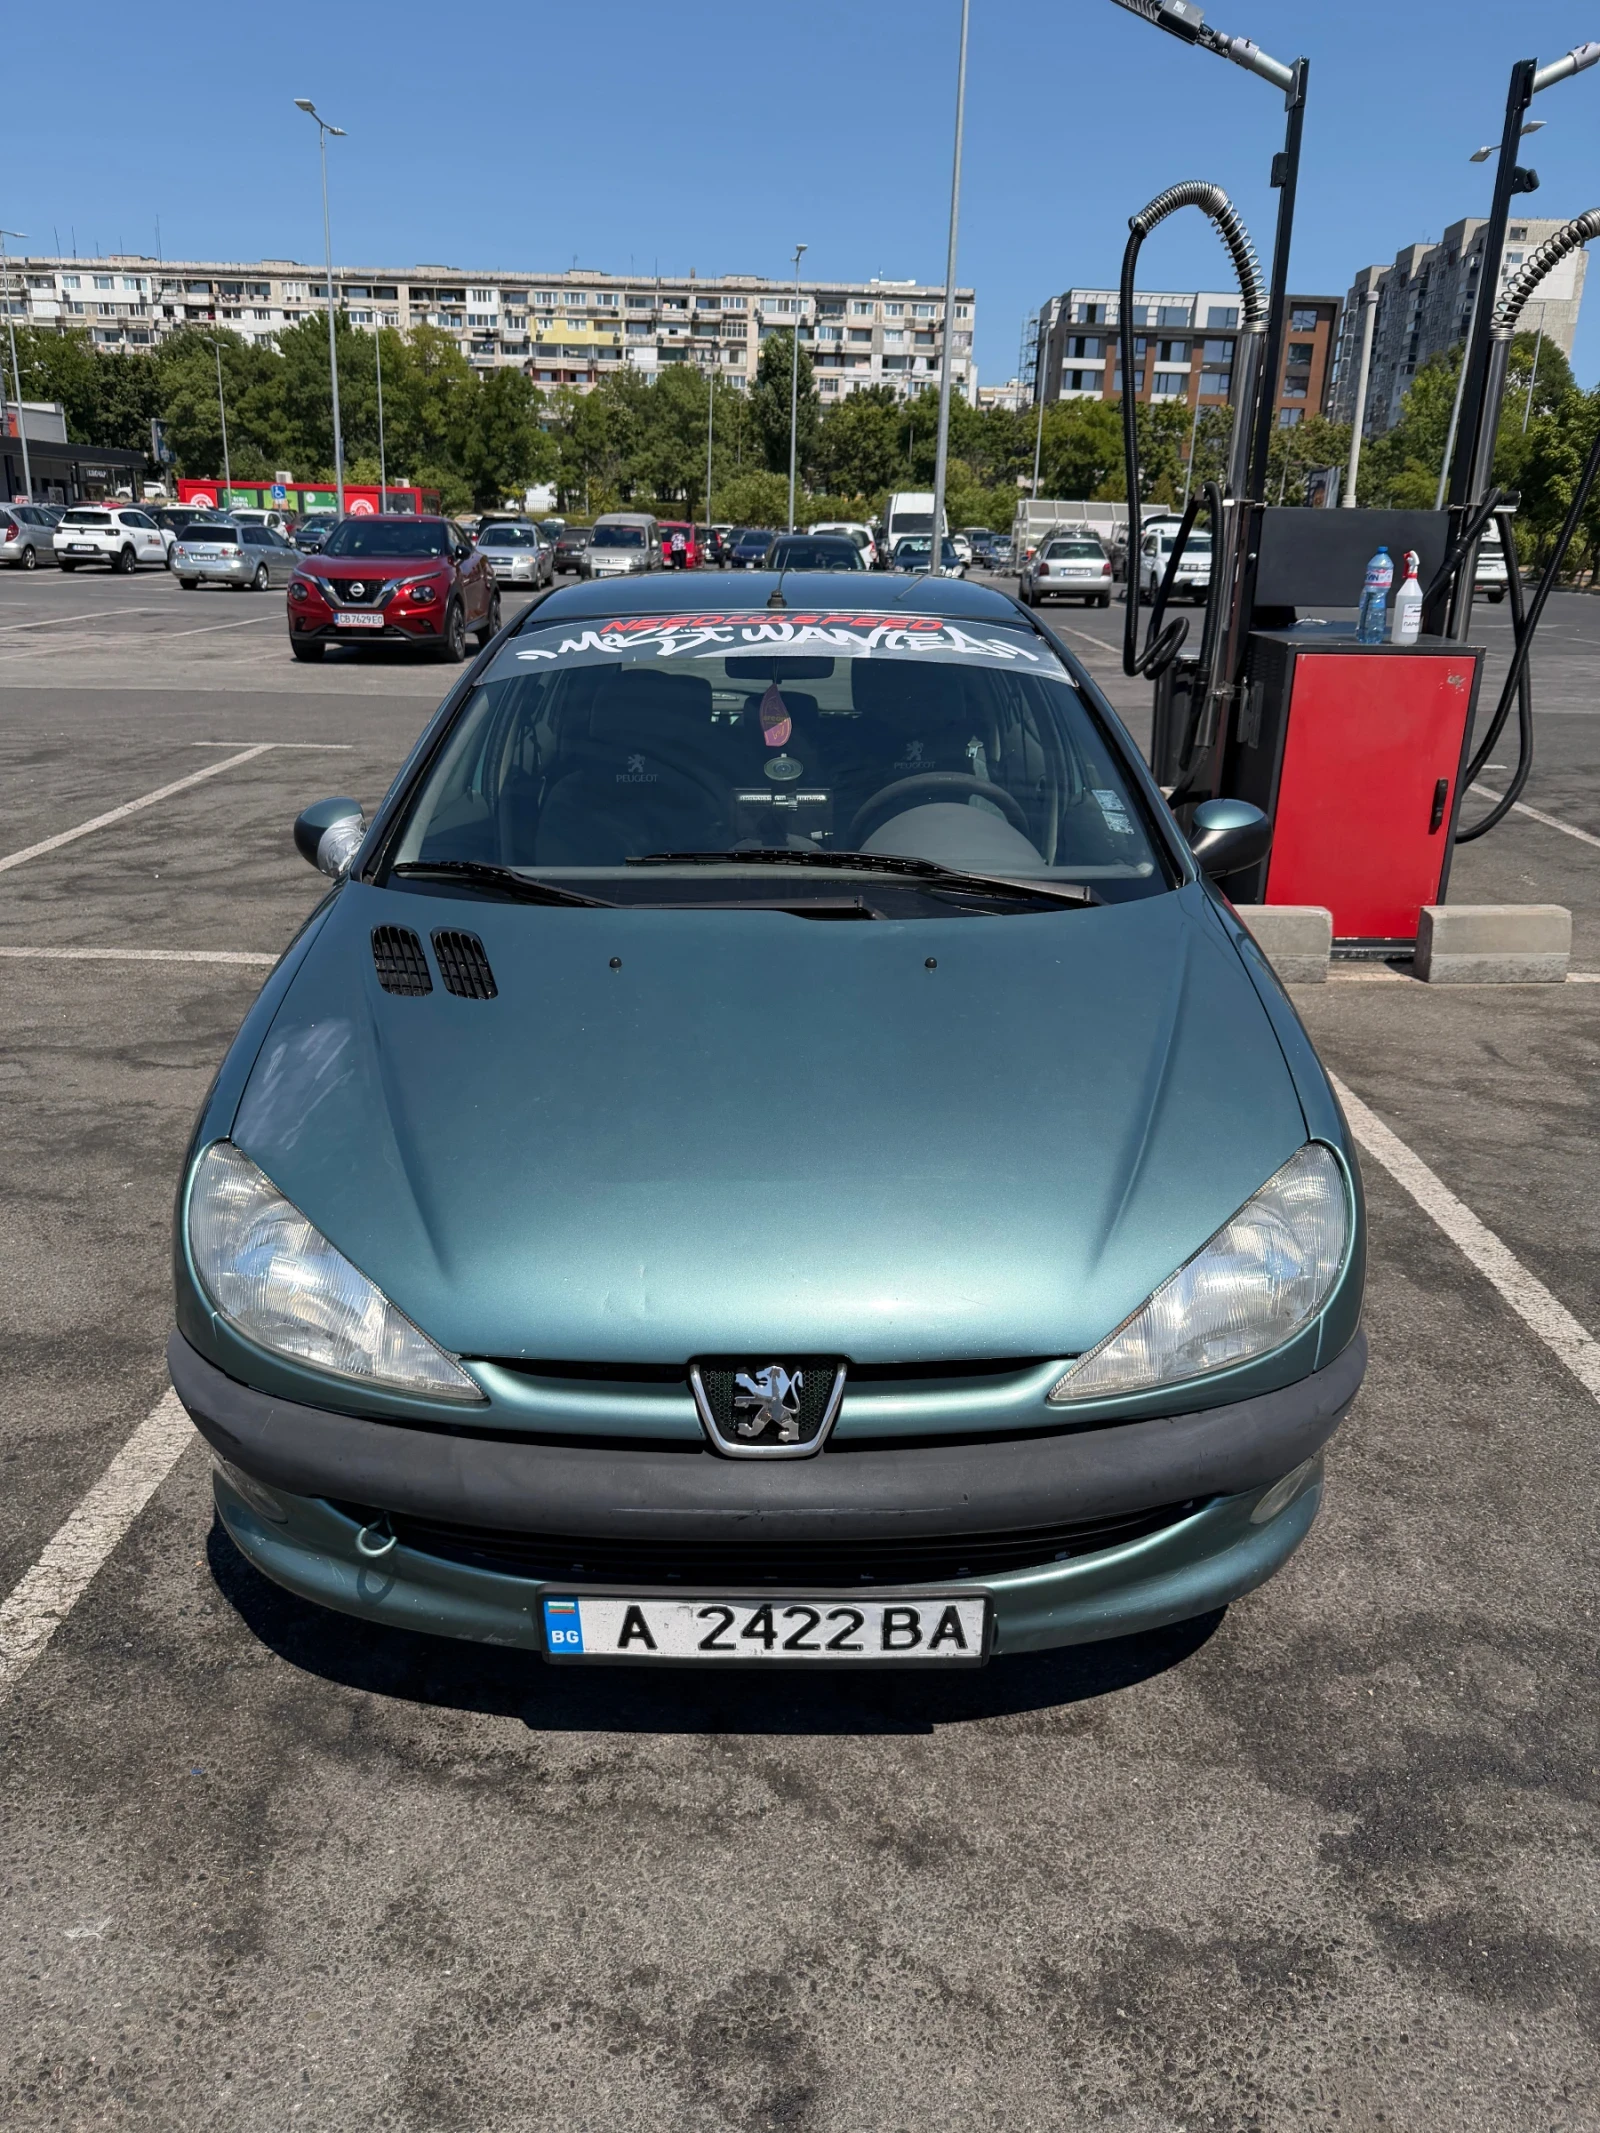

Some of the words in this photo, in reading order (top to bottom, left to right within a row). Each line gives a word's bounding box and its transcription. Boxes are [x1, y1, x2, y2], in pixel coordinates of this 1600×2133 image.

[600, 616, 725, 634] NEED
[792, 615, 943, 631] SPEED
[894, 761, 936, 769] PEUGEOT
[616, 774, 658, 783] PEUGEOT
[617, 1604, 658, 1650] A
[697, 1603, 866, 1651] 2422
[882, 1604, 969, 1651] BA
[551, 1630, 579, 1643] BG
